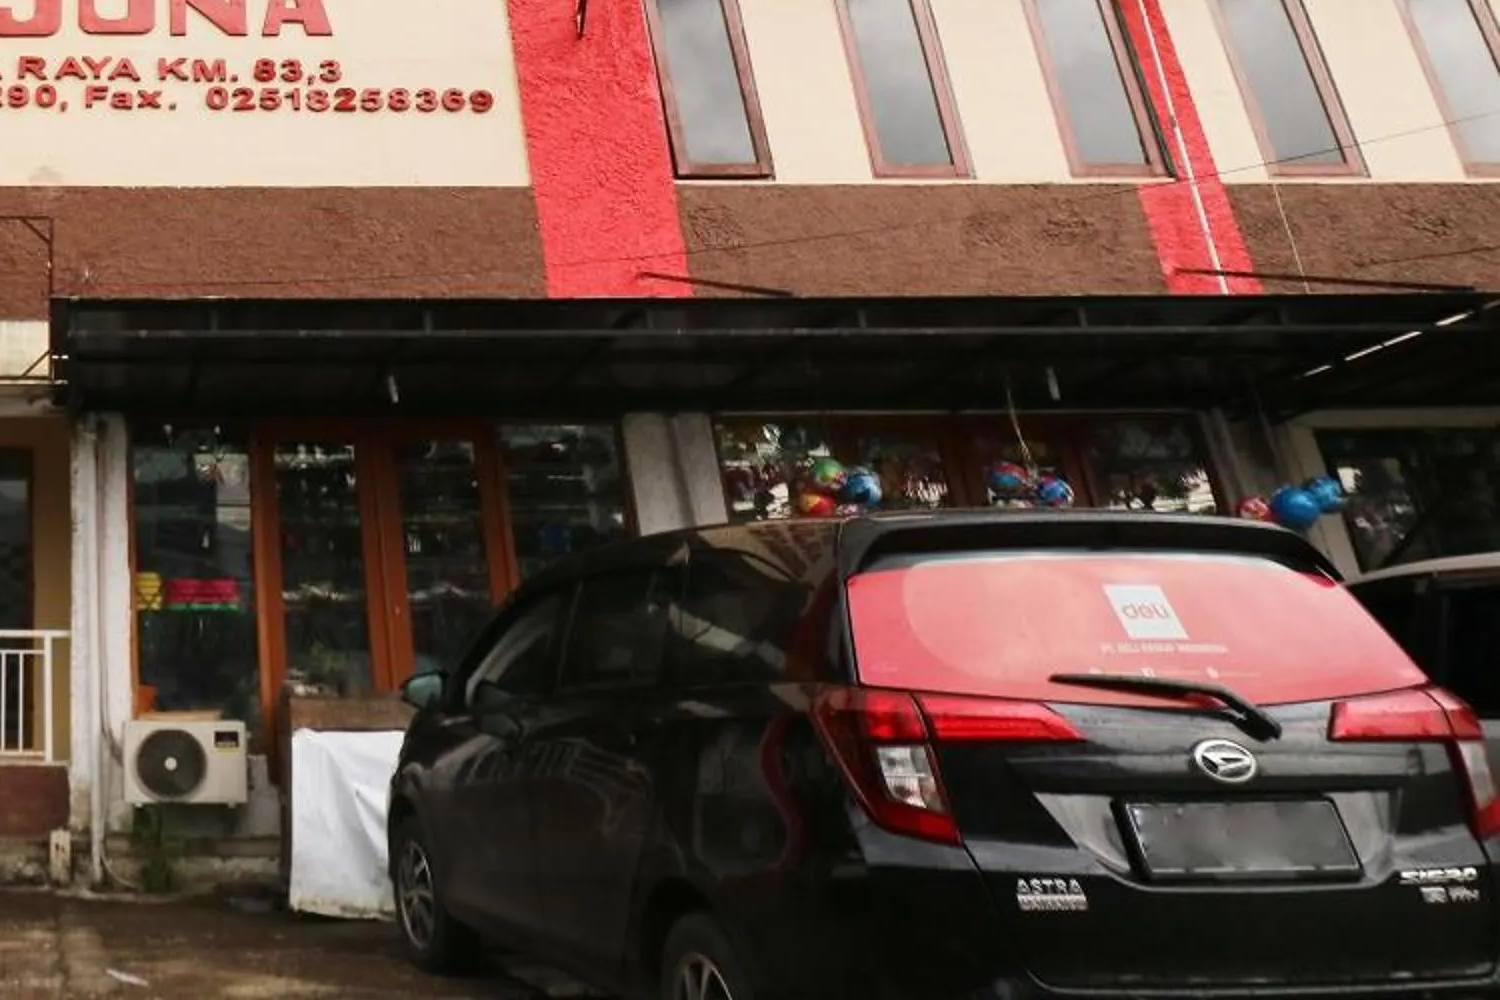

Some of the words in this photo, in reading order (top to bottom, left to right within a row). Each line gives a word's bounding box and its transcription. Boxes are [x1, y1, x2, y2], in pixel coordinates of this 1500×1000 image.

[17, 56, 141, 82] RAYA
[157, 57, 240, 82] KM.
[253, 58, 343, 85] 83,3
[85, 86, 178, 110] Fax.
[205, 87, 495, 112] 02518258369
[1017, 878, 1085, 895] ASTRA
